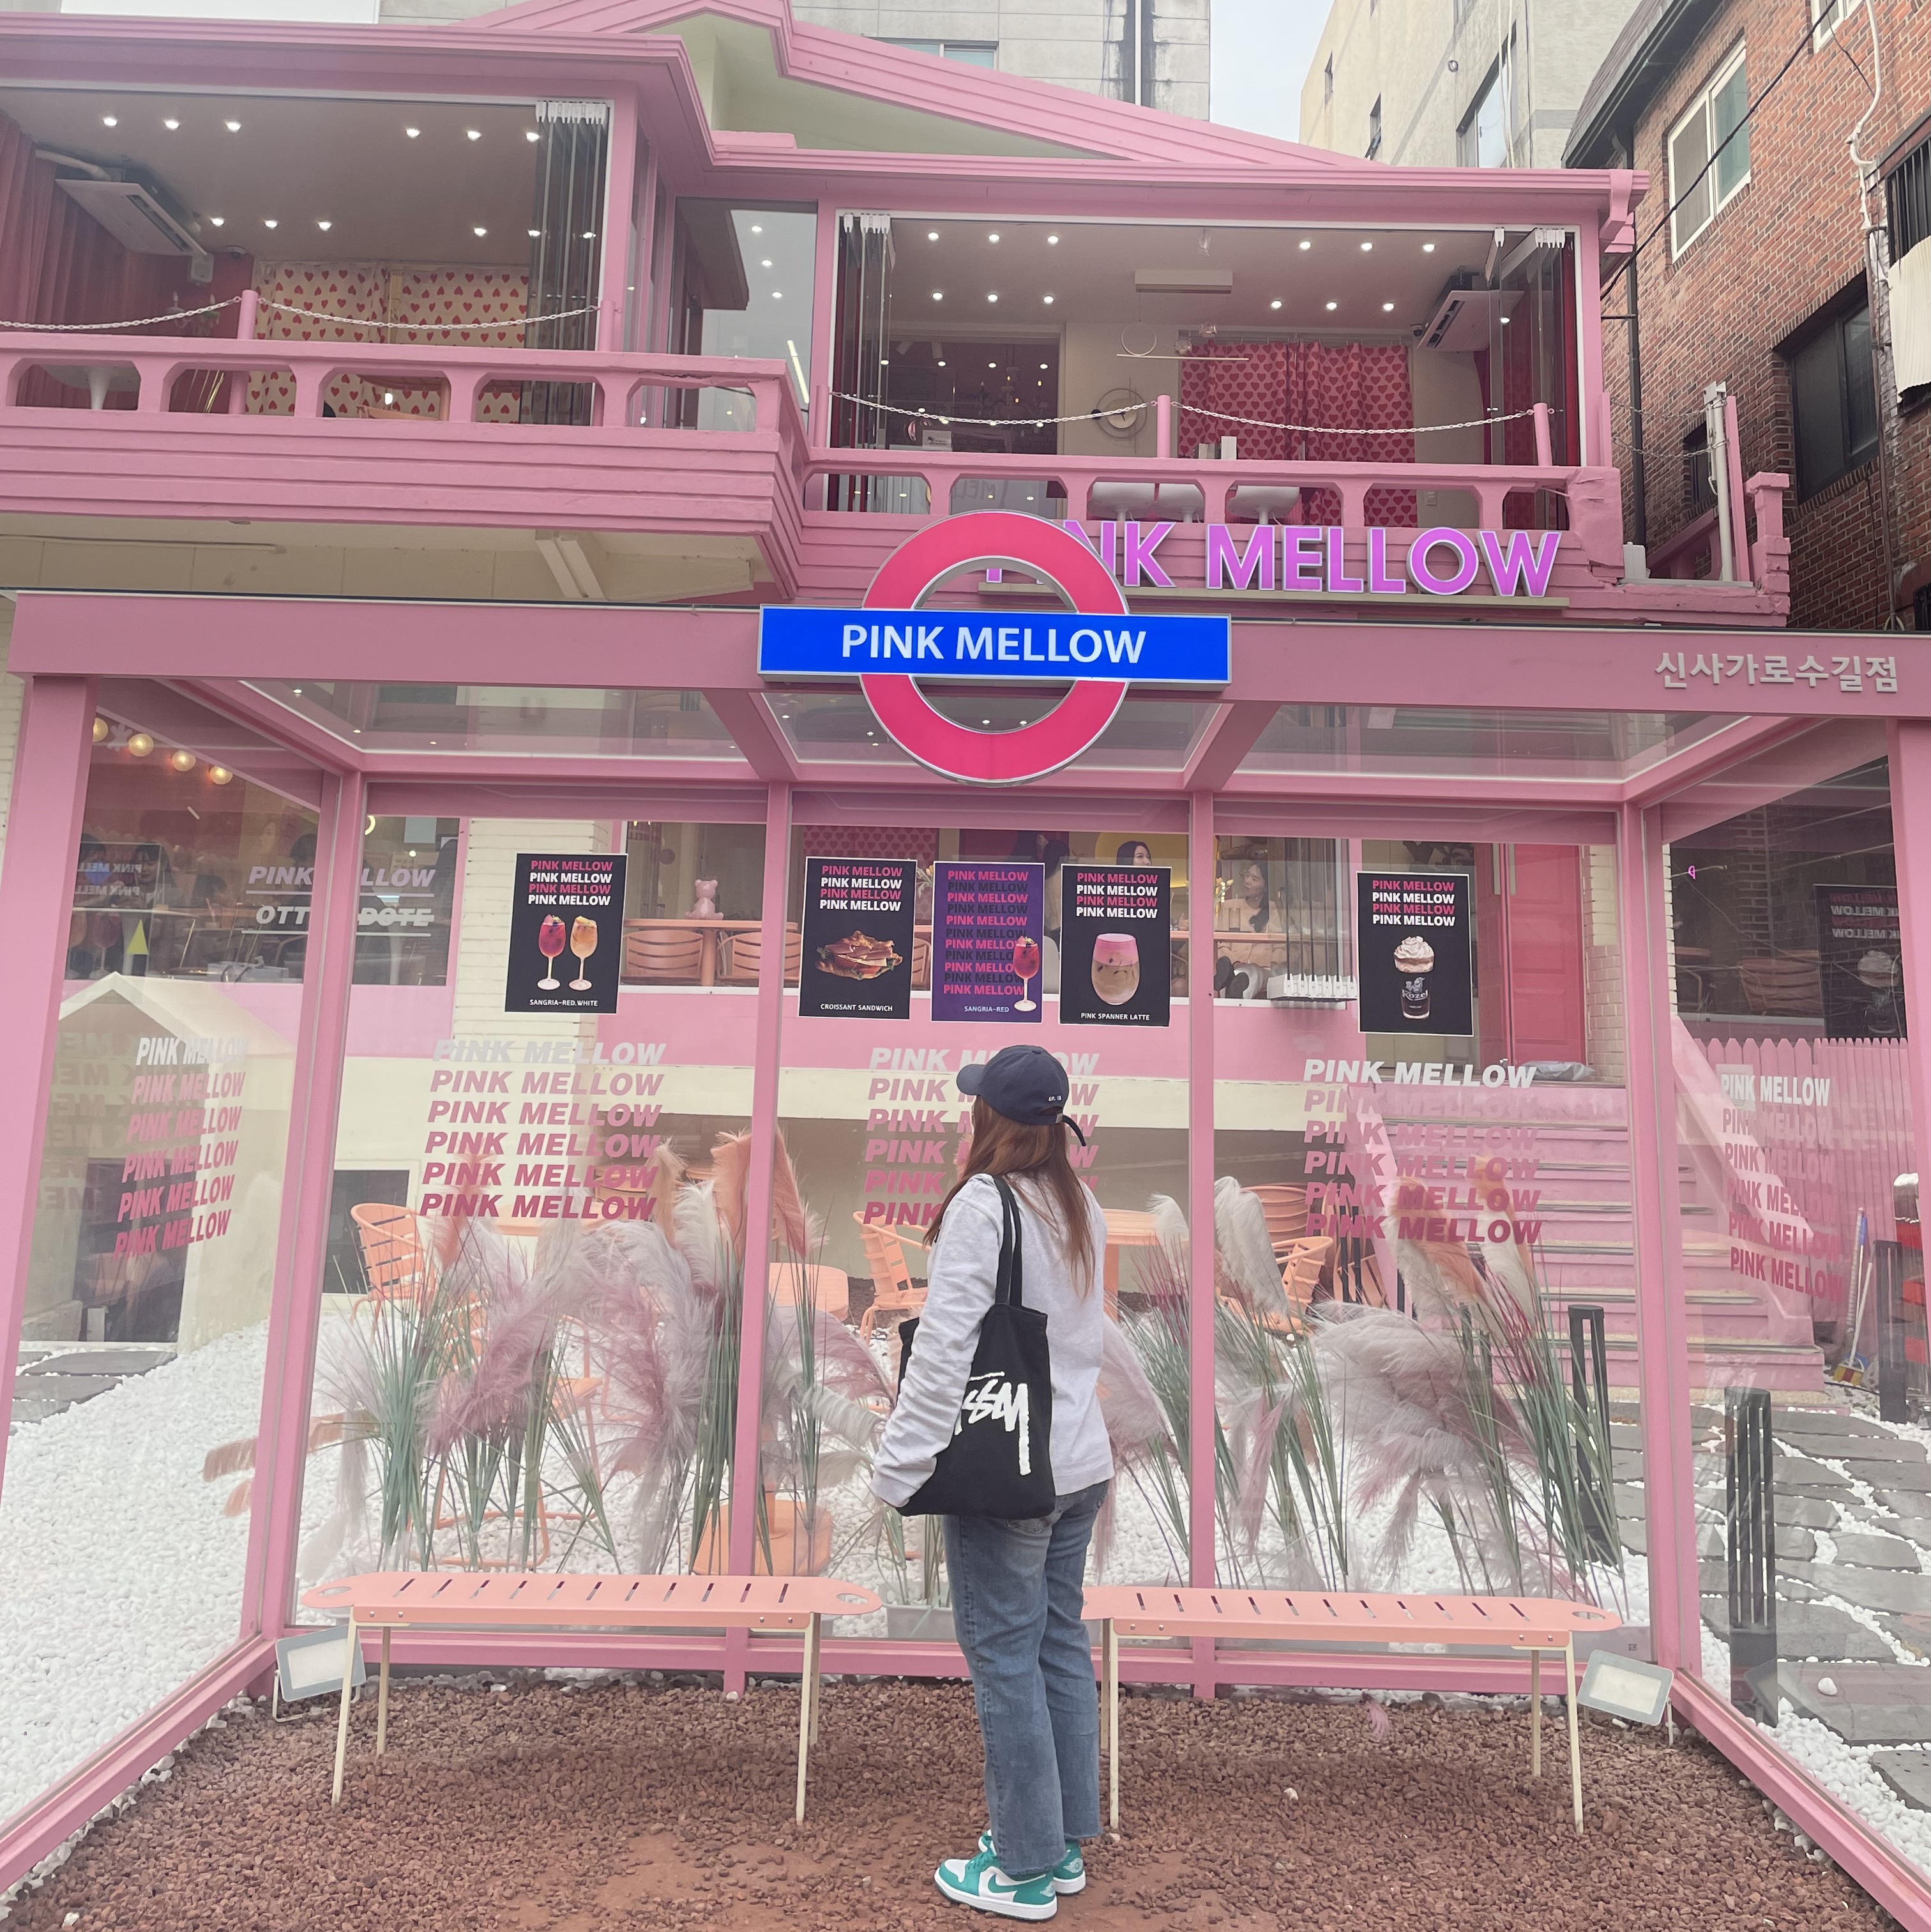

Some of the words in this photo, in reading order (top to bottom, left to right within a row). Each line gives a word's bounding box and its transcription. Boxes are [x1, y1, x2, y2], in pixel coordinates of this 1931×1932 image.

[1205, 523, 1562, 598] MELLOW
[842, 624, 944, 659] PINK
[955, 627, 1146, 664] MELLOW
[1655, 652, 1898, 692] 신사가로수길점
[248, 866, 313, 885] PINK
[530, 872, 558, 882] PINK
[561, 872, 612, 883] MELLOW
[531, 860, 559, 871] PINK
[562, 861, 613, 871] MELLOW
[822, 865, 849, 876] PINK
[852, 866, 903, 877] MELLOW
[948, 871, 976, 880] PINK
[978, 872, 1029, 881] MELLOW
[529, 883, 557, 894] PINK
[559, 884, 611, 894] MELLOW
[821, 878, 849, 888] PINK
[851, 878, 902, 889] MELLOW
[948, 882, 974, 892] PINK
[1077, 872, 1105, 883] PINK
[1107, 874, 1158, 884] MELLOW
[1372, 880, 1400, 890] PINK
[1404, 881, 1455, 892] MELLOW
[528, 894, 557, 904] PINK
[559, 895, 611, 906] MELLOW
[820, 888, 848, 899] PINK
[851, 890, 902, 900] MELLOW
[947, 892, 976, 902] PINK
[978, 894, 1028, 903] MELLOW
[1077, 885, 1104, 895] PINK
[1107, 886, 1158, 896] MELLOW
[1077, 896, 1104, 906] PINK
[1107, 897, 1157, 907] MELLOW
[1372, 892, 1401, 902] PINK
[1404, 894, 1455, 904] MELLOW
[819, 899, 848, 909] PINK
[850, 901, 901, 911] MELLOW
[948, 904, 974, 913] PINK
[1076, 907, 1104, 917] PINK
[1107, 908, 1158, 918] MELLOW
[1372, 903, 1401, 913] PINK
[1404, 904, 1455, 915] MELLOW
[946, 915, 974, 925] PINK
[977, 917, 1027, 926] MELLOW
[1373, 915, 1402, 925] PINK
[1404, 916, 1456, 926] MELLOW
[945, 939, 973, 949] PINK
[976, 940, 1017, 950] MELLO
[946, 929, 973, 938] PINK
[944, 962, 973, 972] PINK
[975, 963, 1015, 973] MELLO
[945, 950, 972, 960] PINK
[976, 952, 1013, 961] MELLO
[943, 985, 971, 994] PINK
[944, 973, 971, 982] PINK
[135, 1037, 181, 1065] PINK
[432, 1039, 516, 1063] PINK
[523, 1042, 667, 1065] MELLOW
[870, 1047, 951, 1072] PINK
[430, 1070, 513, 1093] PINK
[520, 1072, 665, 1095] MELLOW
[1303, 1058, 1385, 1084] PINK
[1393, 1061, 1536, 1089] MELLOW
[132, 1074, 177, 1104] PINK
[179, 1072, 246, 1101] MELLOW
[868, 1078, 949, 1102] PINK
[1721, 1074, 1755, 1102] PINK
[1761, 1076, 1830, 1106] MELLOW
[427, 1100, 511, 1124] PINK
[519, 1102, 663, 1127] MELLOW
[1303, 1090, 1387, 1114] PINK
[127, 1112, 173, 1143] PINK
[174, 1106, 243, 1138] MELLOW
[866, 1109, 948, 1133] PINK
[425, 1131, 508, 1155] PINK
[516, 1133, 662, 1158] MELLOW
[1303, 1120, 1385, 1145] PINK
[1397, 1123, 1538, 1150] MELLOW
[122, 1150, 168, 1183] PINK
[170, 1140, 239, 1175] MELLOW
[865, 1139, 948, 1164] PINK
[1725, 1143, 1759, 1173] PINK
[422, 1162, 506, 1186] PINK
[513, 1164, 659, 1189] MELLOW
[1304, 1151, 1386, 1176] PINK
[1397, 1154, 1540, 1182] MELLOW
[864, 1169, 947, 1195] PINK
[1727, 1179, 1762, 1209] PINK
[117, 1187, 164, 1222] PINK
[166, 1174, 235, 1213] MELLOW
[420, 1193, 504, 1217] PINK
[511, 1195, 657, 1220] MELLOW
[1305, 1182, 1387, 1207] PINK
[1397, 1185, 1541, 1212] MELLOW
[113, 1225, 160, 1261] PINK
[162, 1208, 231, 1251] MELLOW
[1305, 1213, 1388, 1239] PINK
[1398, 1217, 1543, 1244] MELLOW
[1729, 1211, 1764, 1245] PINK
[1730, 1246, 1766, 1282] PINK
[1771, 1258, 1844, 1302] MELLOW
